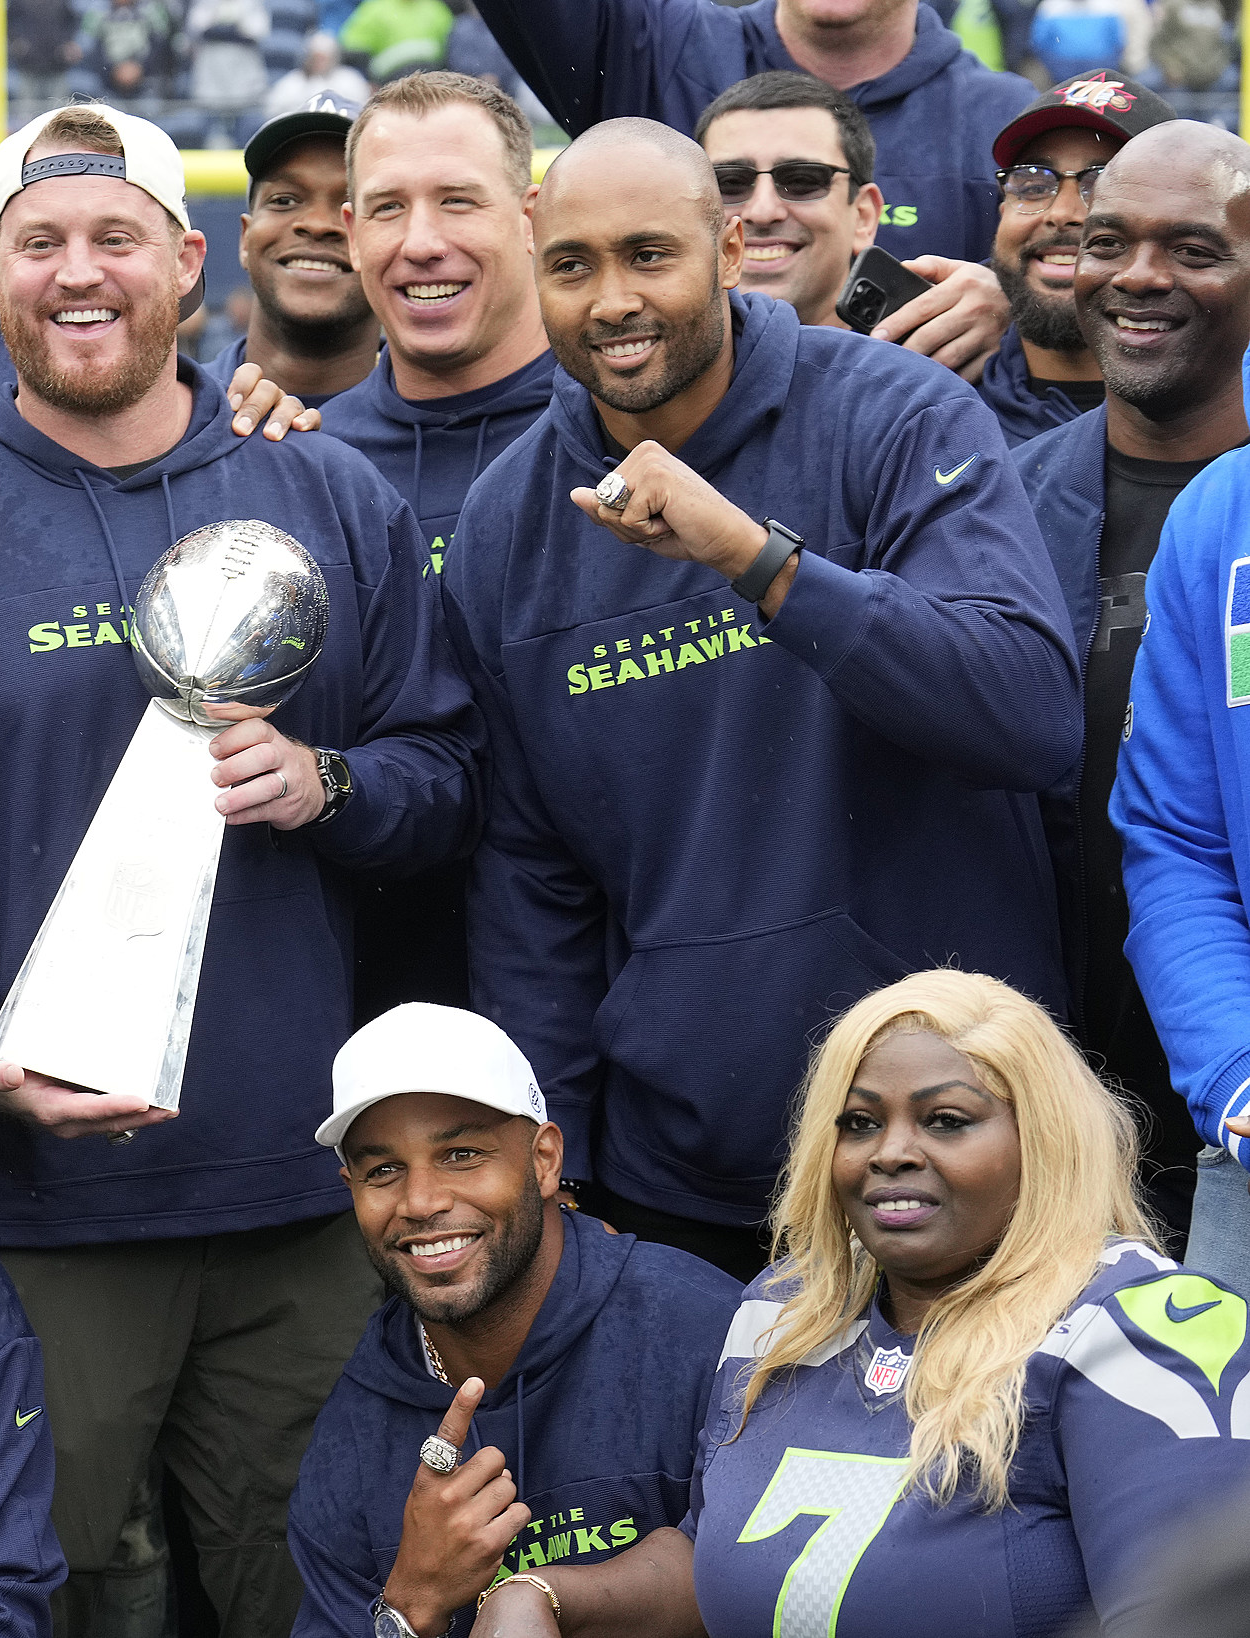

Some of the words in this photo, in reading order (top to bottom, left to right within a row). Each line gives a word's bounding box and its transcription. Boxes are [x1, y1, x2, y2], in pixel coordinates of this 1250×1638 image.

[593, 608, 736, 658] SEATTLE
[567, 624, 773, 695] SEAHAWK
[871, 1365, 897, 1387] NFL
[516, 1508, 584, 1539] TTLE
[736, 1447, 914, 1638] 7
